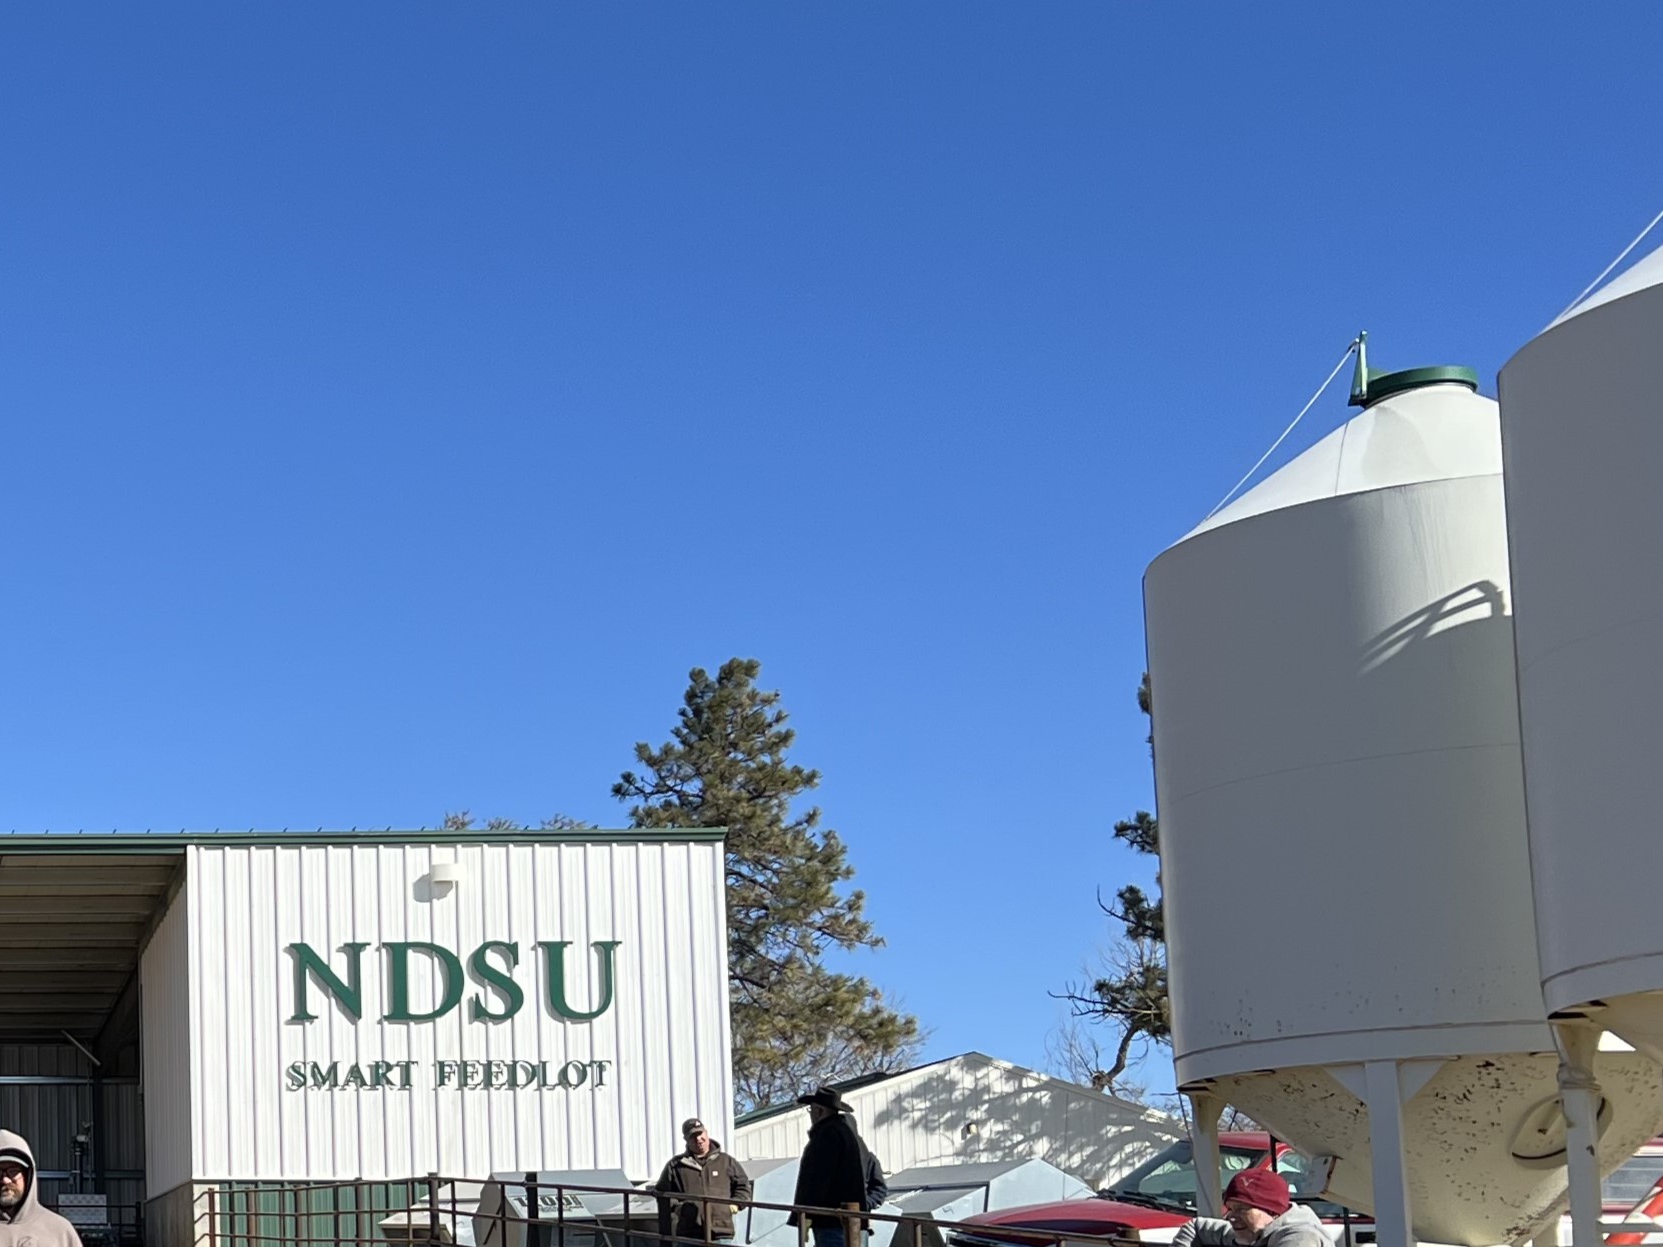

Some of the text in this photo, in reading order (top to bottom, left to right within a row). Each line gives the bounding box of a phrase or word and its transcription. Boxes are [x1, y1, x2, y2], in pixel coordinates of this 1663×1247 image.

[289, 940, 622, 1021] NDSU
[287, 1060, 611, 1090] SMART FEEDLOT
